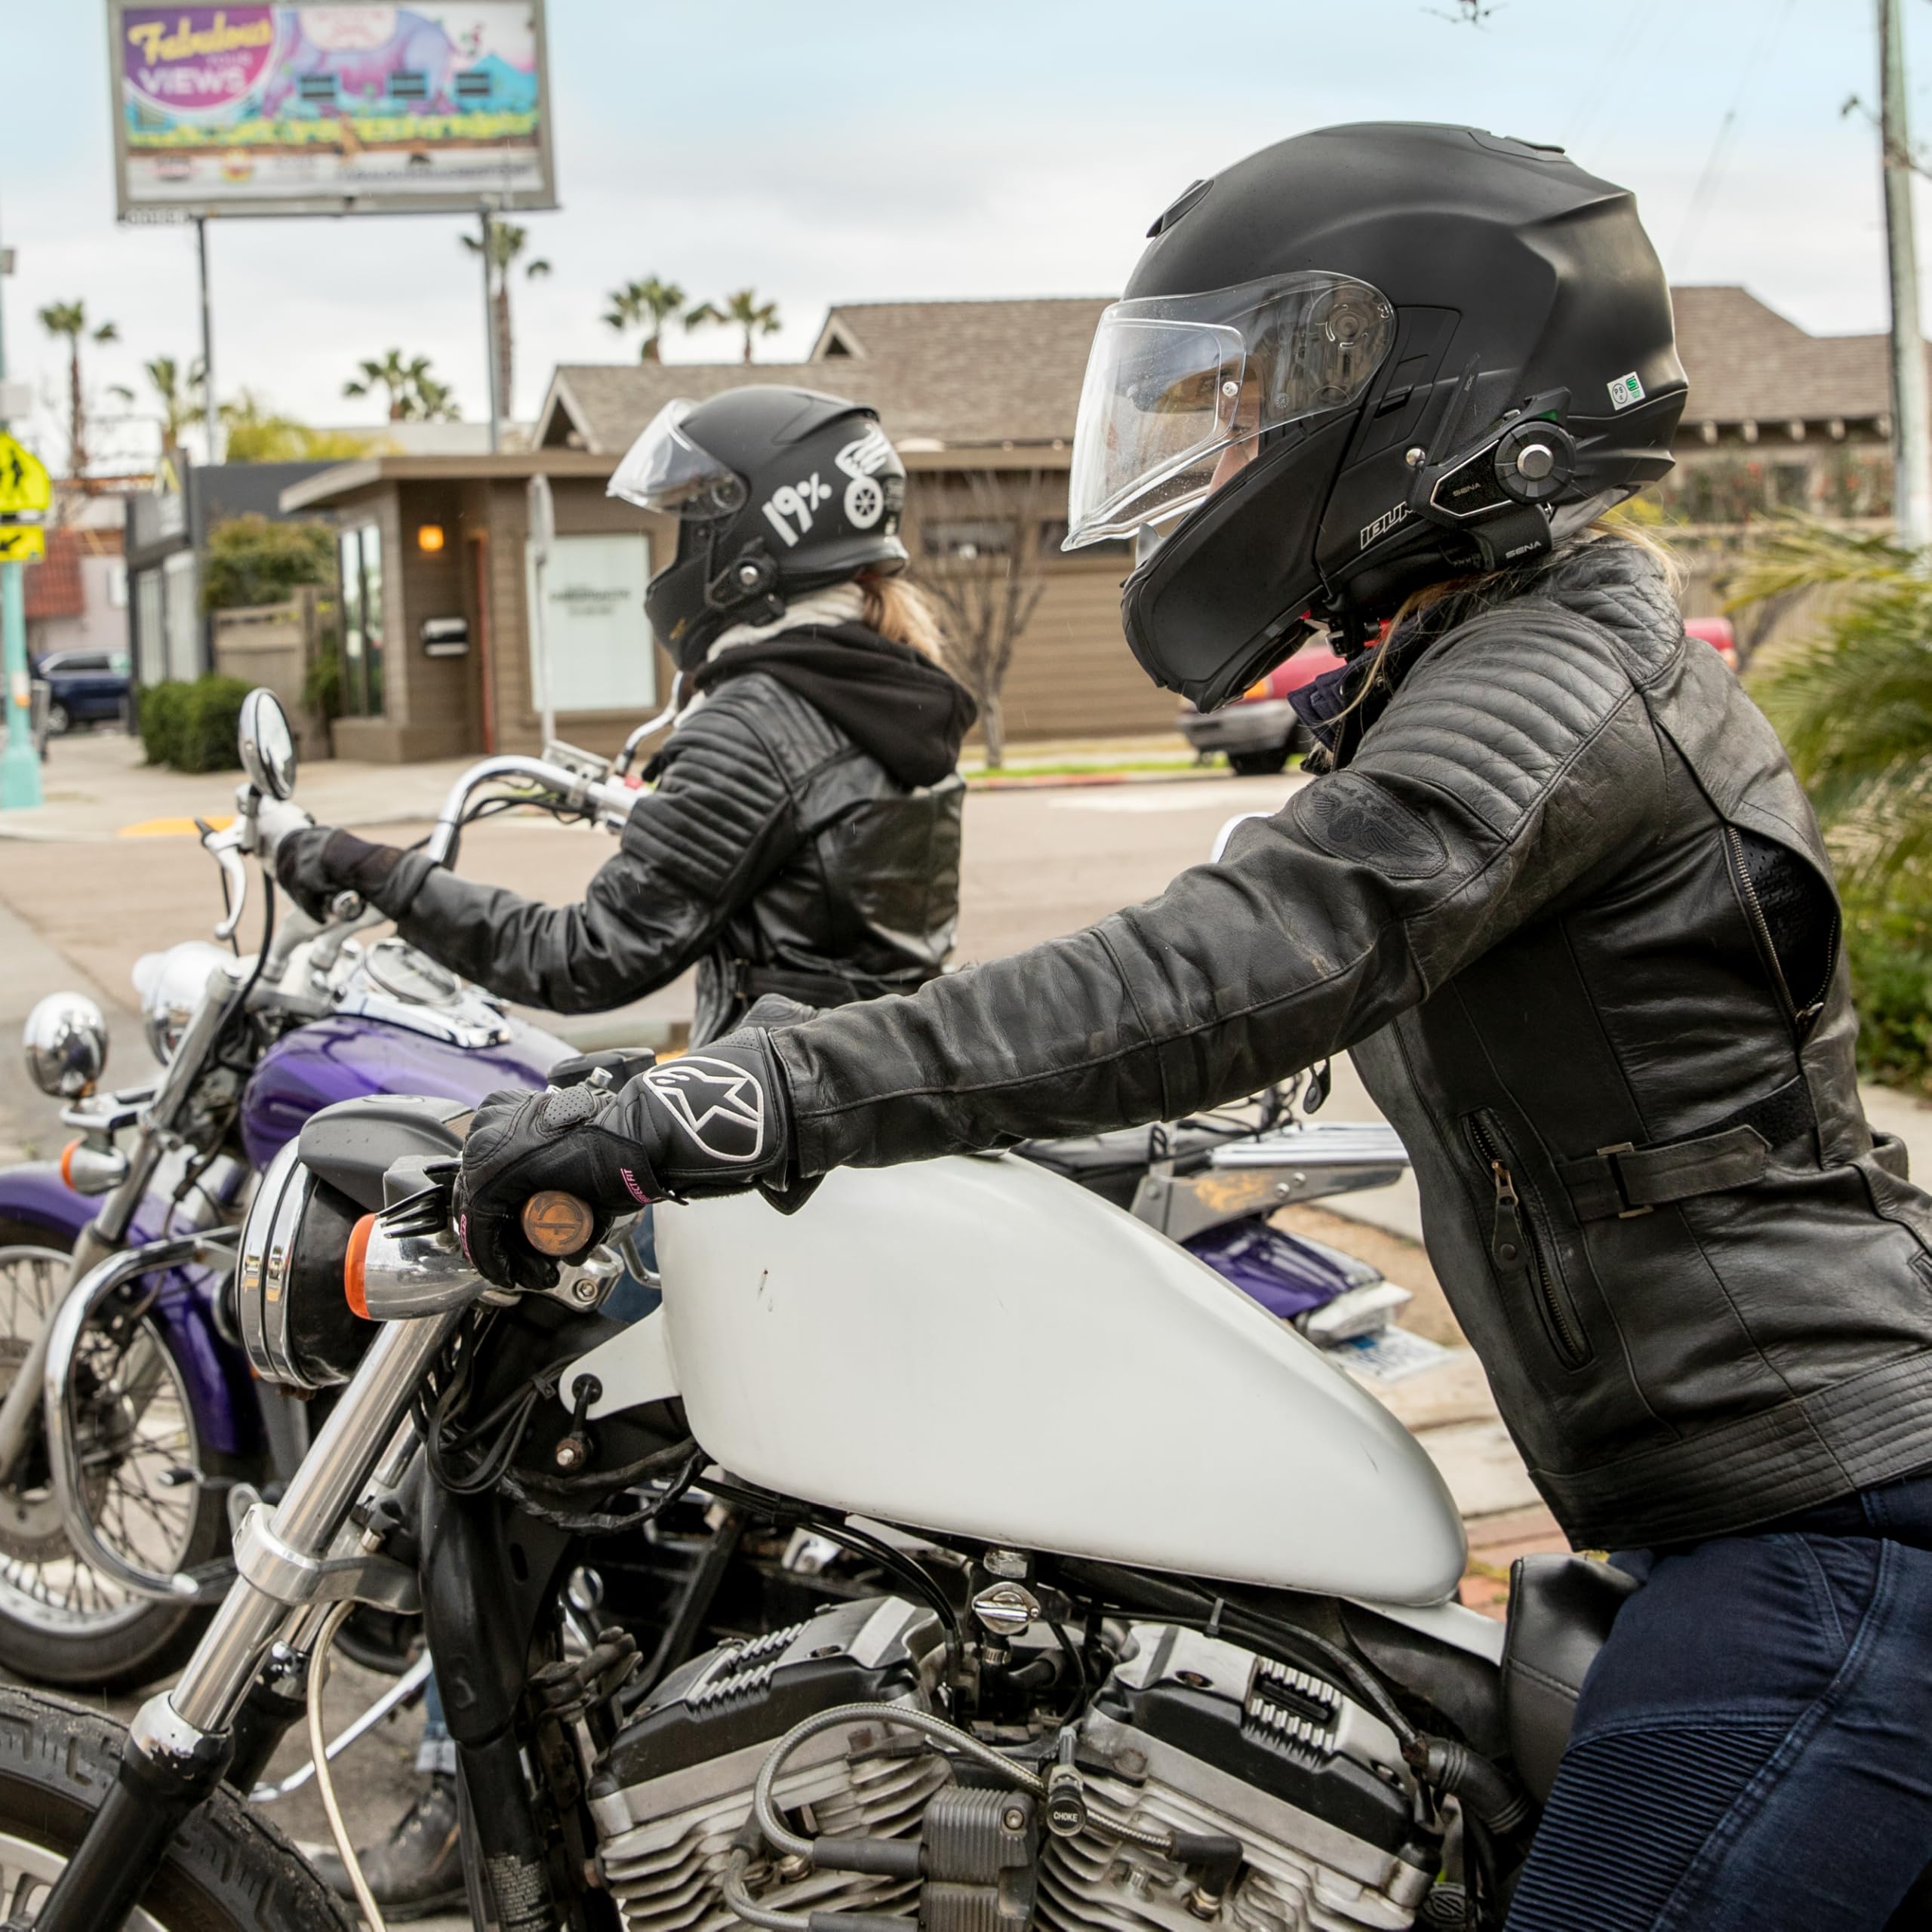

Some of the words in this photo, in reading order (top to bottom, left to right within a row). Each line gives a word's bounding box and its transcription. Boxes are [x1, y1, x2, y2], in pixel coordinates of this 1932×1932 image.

[137, 66, 245, 95] VIEWS
[1453, 483, 1481, 497] SENA
[761, 472, 832, 548] 19%
[1505, 541, 1542, 558] SENA
[1053, 1811, 1078, 1823] CHOKE
